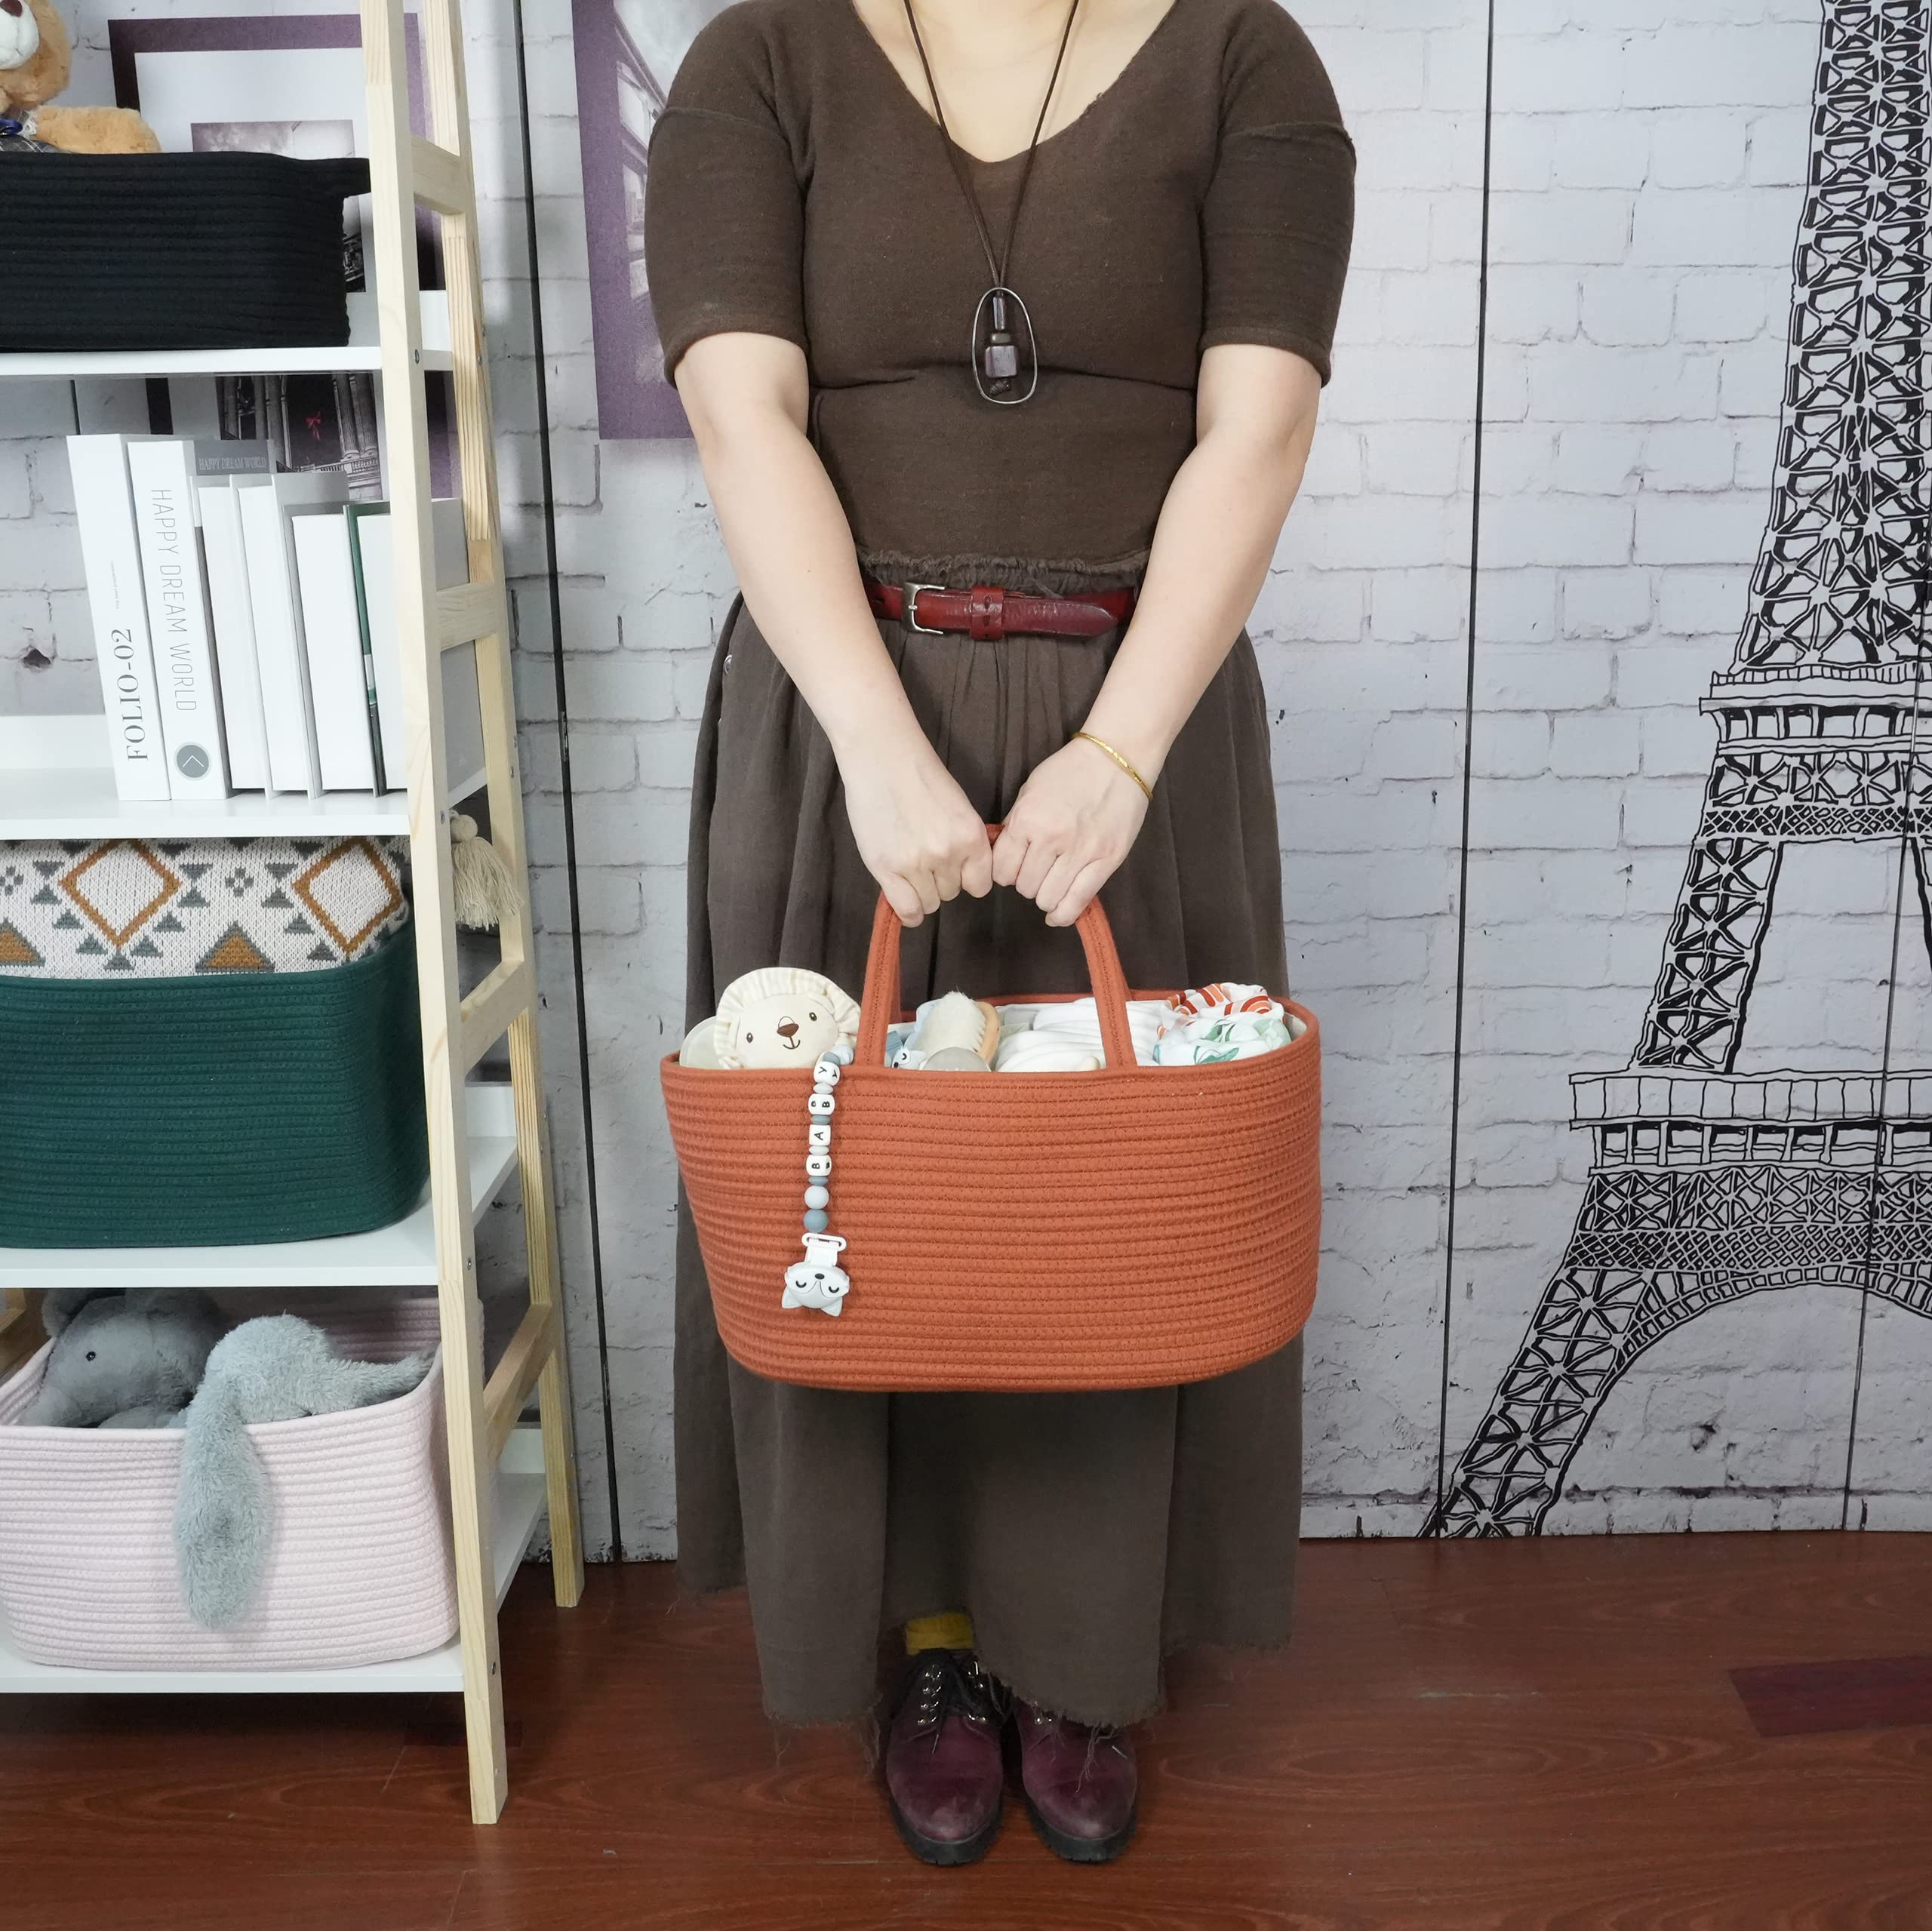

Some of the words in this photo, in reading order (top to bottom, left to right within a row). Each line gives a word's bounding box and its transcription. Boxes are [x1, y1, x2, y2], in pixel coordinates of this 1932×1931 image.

[198, 458, 220, 470] HAPPY
[151, 490, 179, 554] HAPPY
[160, 565, 188, 632] DREAM
[111, 629, 149, 761] FOLIO-02
[170, 643, 197, 711] WORLD
